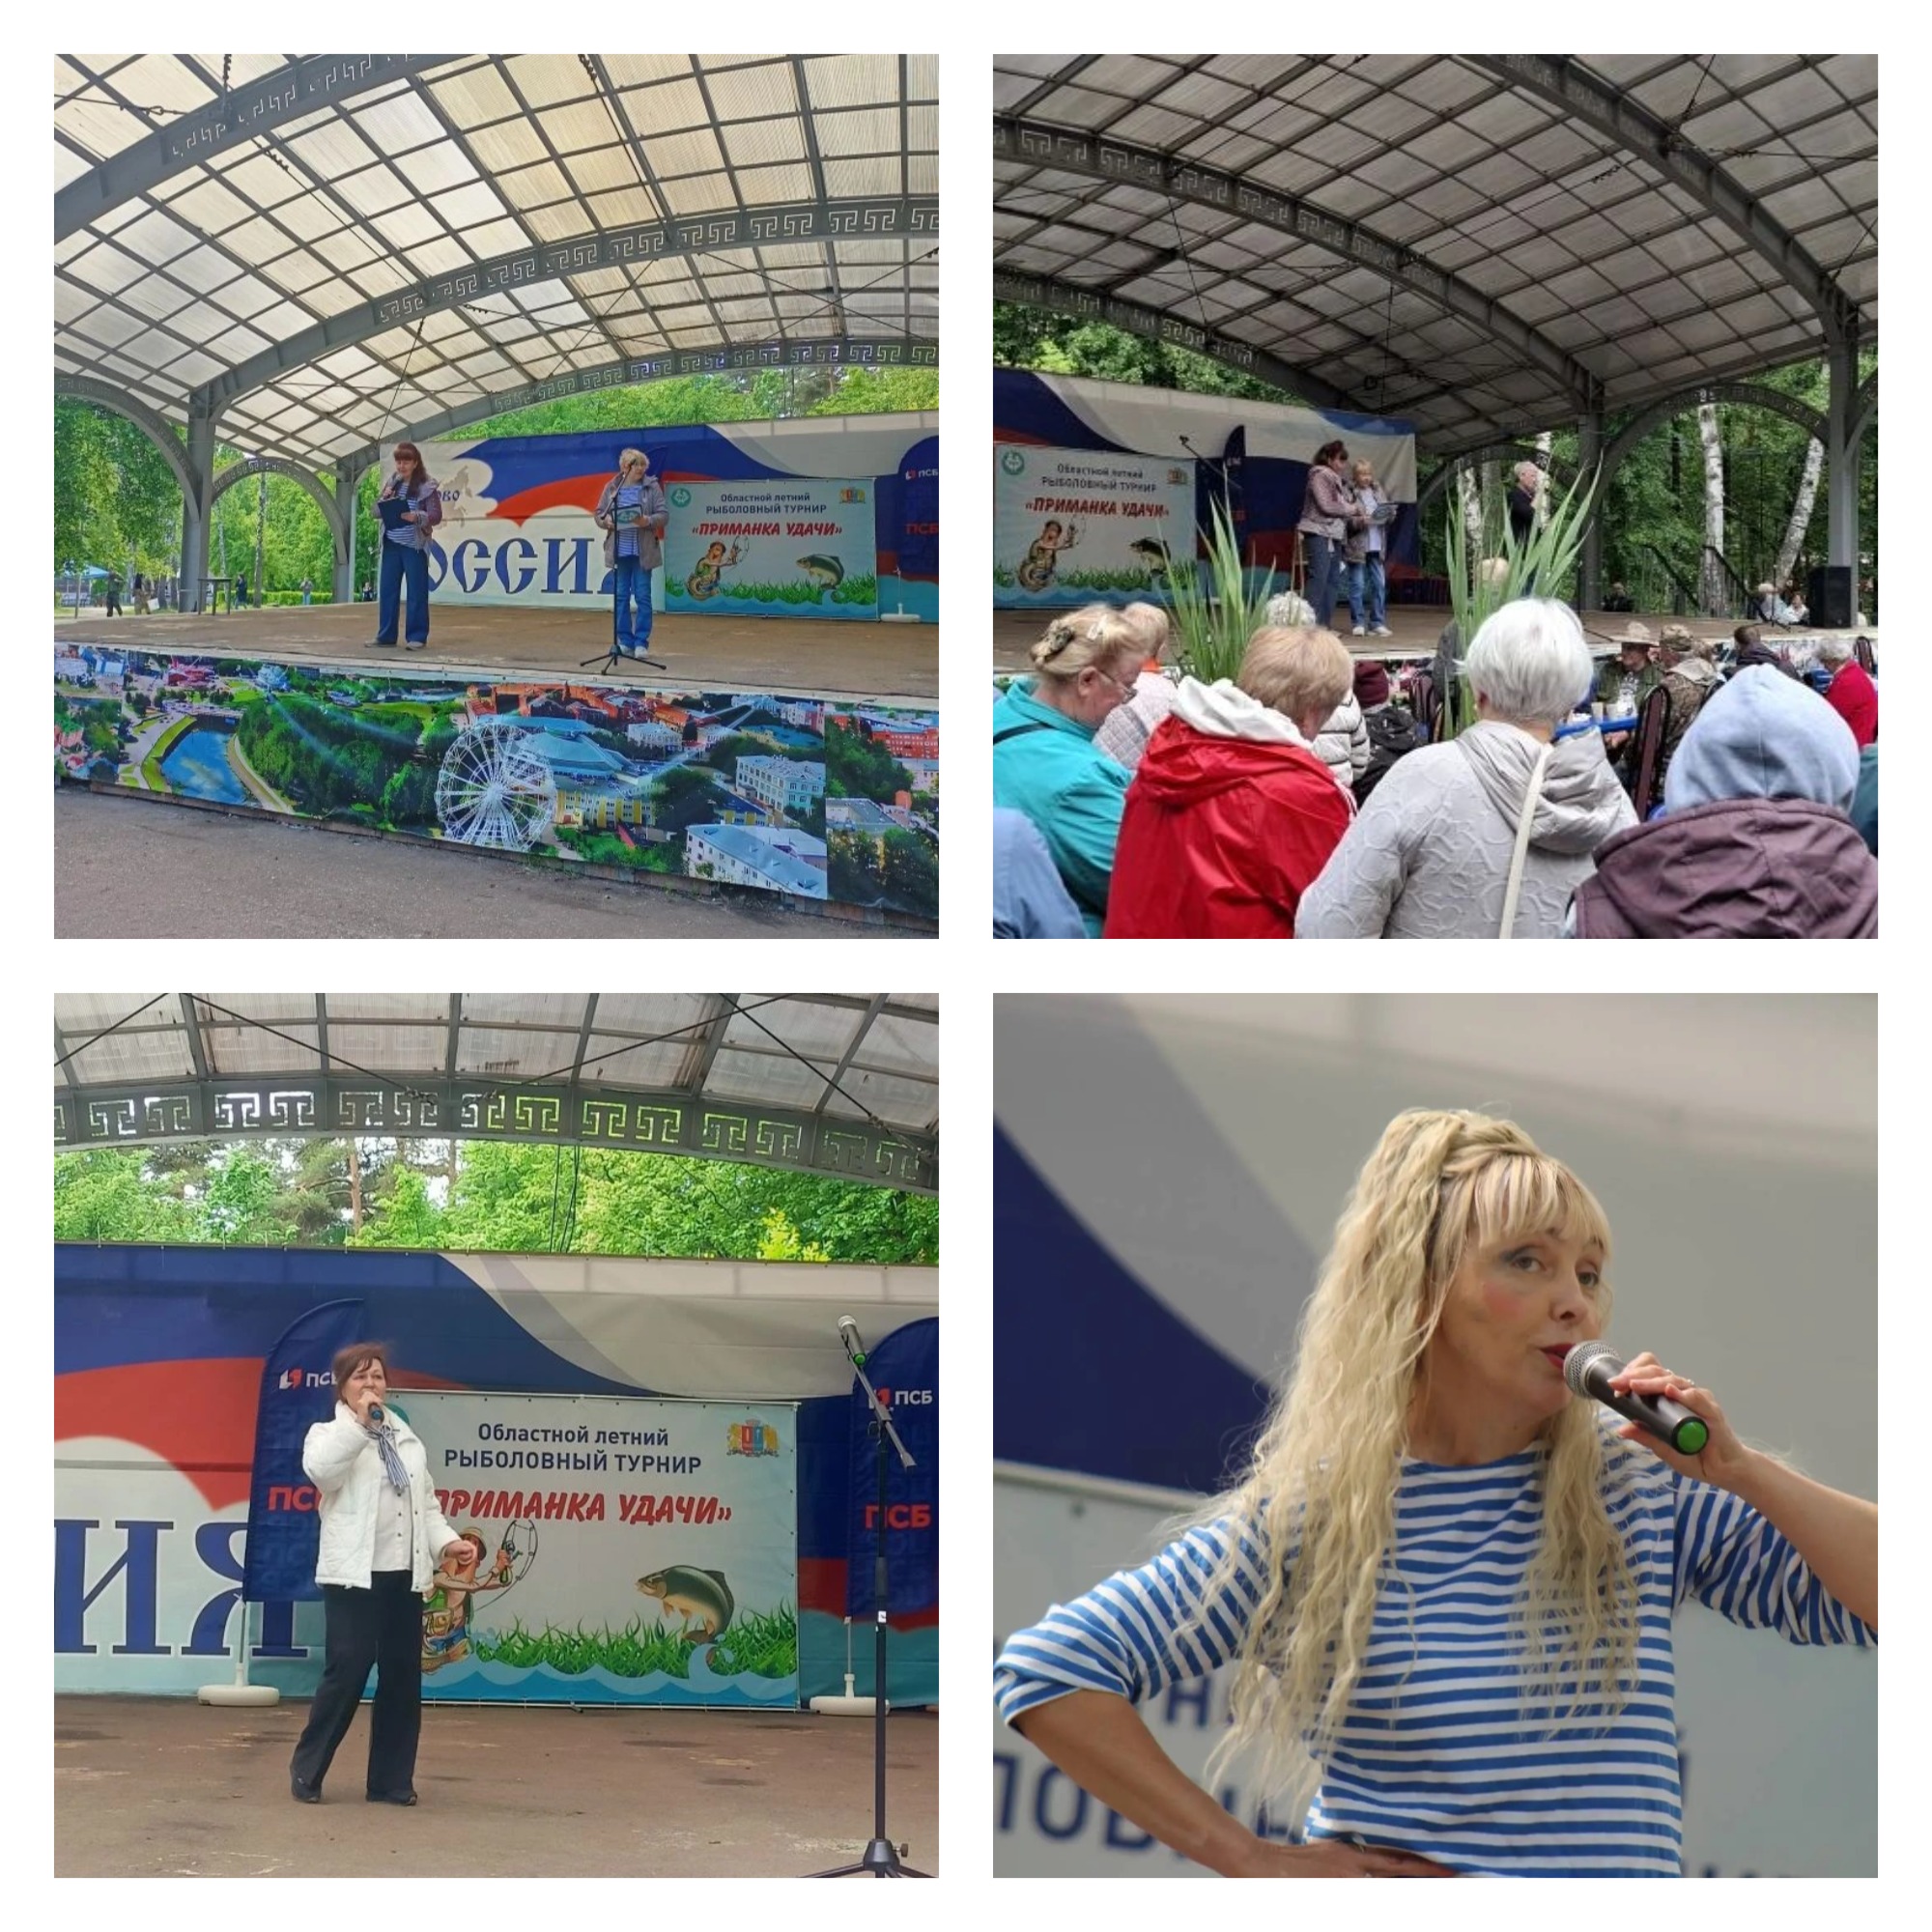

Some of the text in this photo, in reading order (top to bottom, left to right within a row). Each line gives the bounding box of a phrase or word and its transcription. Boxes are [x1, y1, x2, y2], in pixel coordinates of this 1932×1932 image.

[918, 469, 939, 478] ПСБ
[1057, 463, 1110, 476] Областной
[1041, 476, 1157, 493] РЫБОЛОВНЫЙ ТУРНИР
[721, 492, 810, 502] Областной летний
[706, 502, 827, 514] РЫБОЛОВНЫЙ ТУРНИР
[1026, 497, 1169, 518] «ПРИМАНКА УДАЧИ»
[692, 523, 842, 537] «ПРИМАНКА УДАЧИ»
[905, 523, 939, 535] ПСБ
[895, 1389, 933, 1406] ПСБ
[478, 1423, 668, 1446] Областной летний
[444, 1449, 702, 1474] РЫБОЛОВНЫЙ ТУРНИР
[269, 1486, 322, 1512] ПС
[618, 1493, 732, 1525] УДАЧИ»
[865, 1504, 932, 1530] ПСБ
